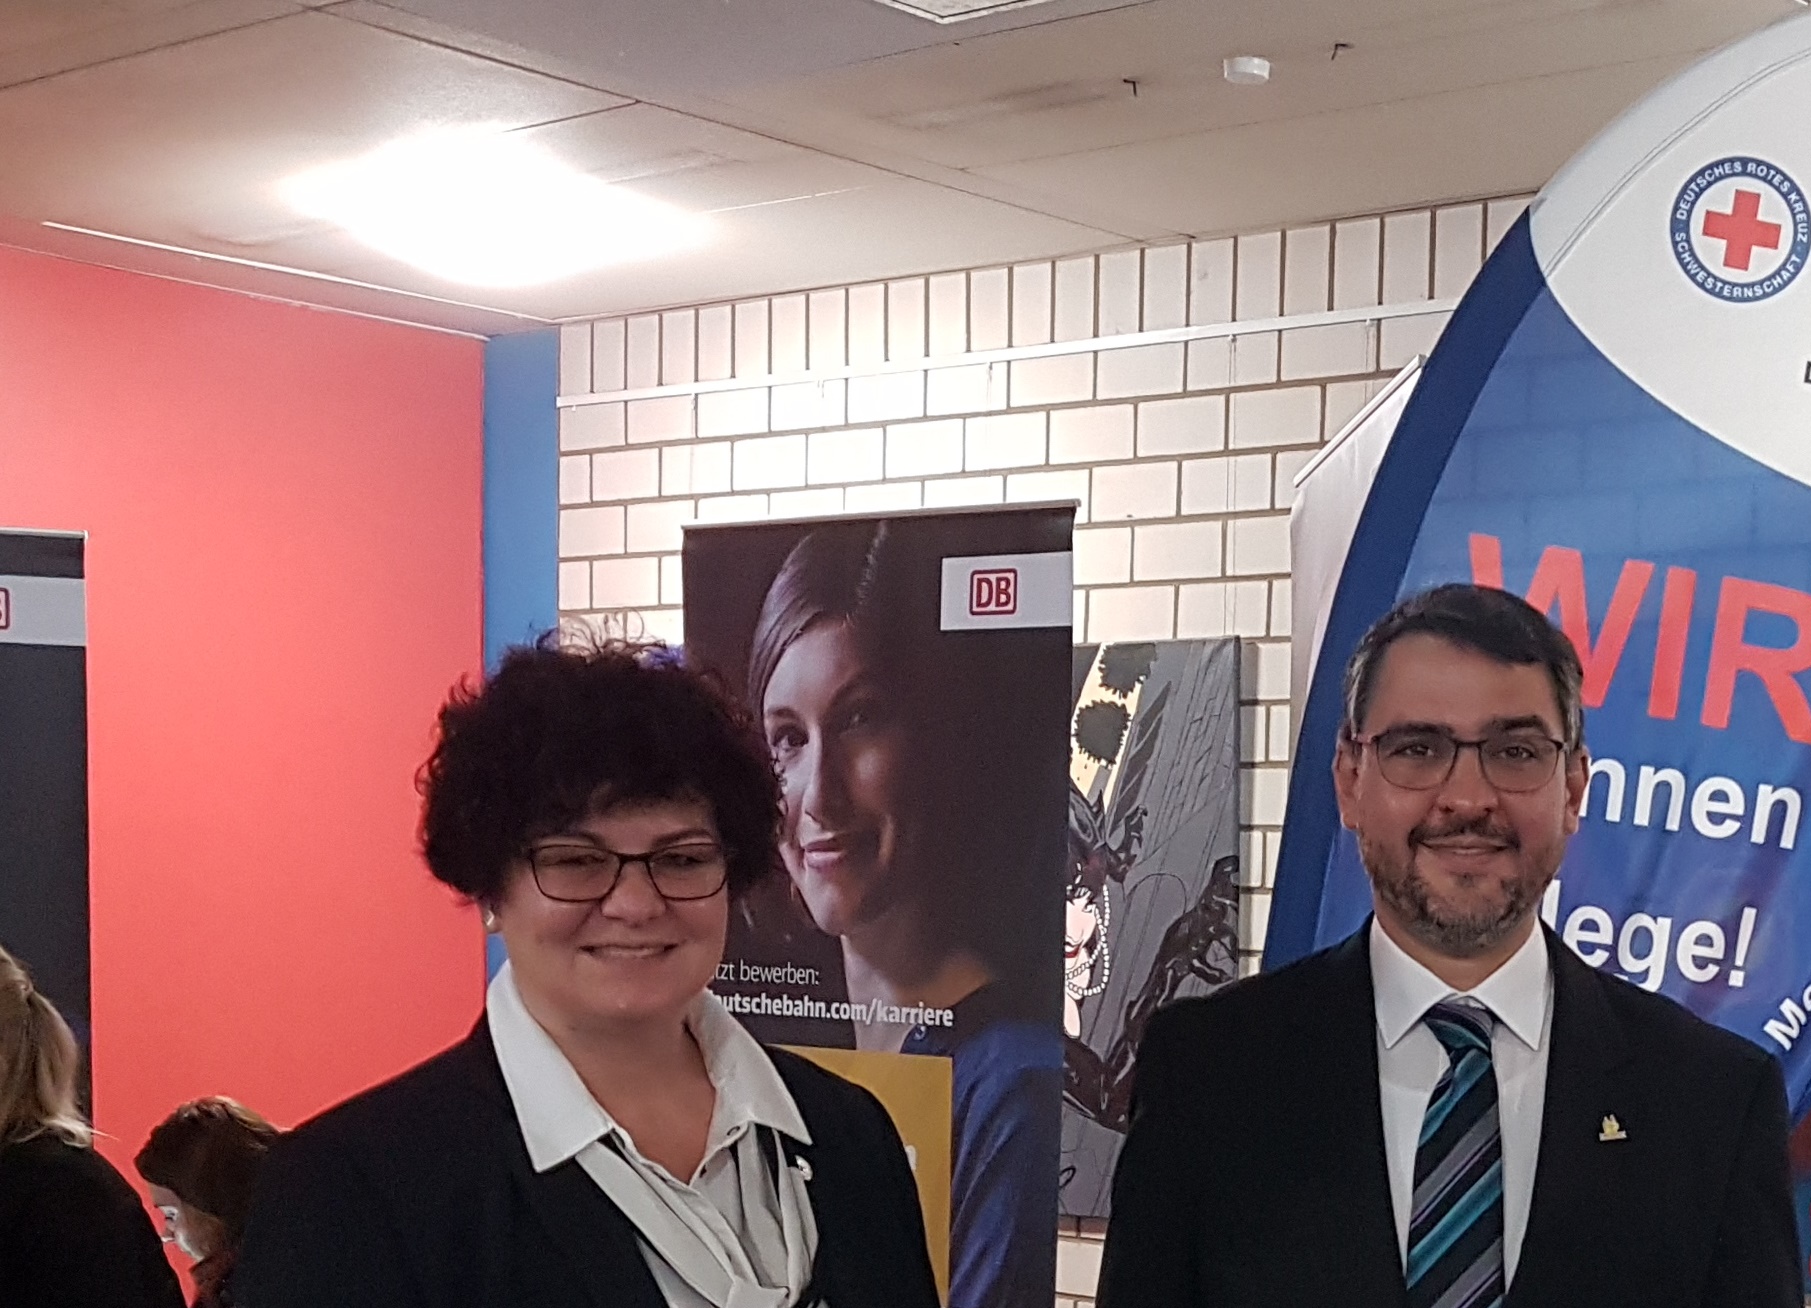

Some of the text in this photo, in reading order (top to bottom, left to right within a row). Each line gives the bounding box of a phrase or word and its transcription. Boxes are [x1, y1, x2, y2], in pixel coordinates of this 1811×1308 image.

[1676, 161, 1809, 243] DEUTSCHES ROTES KREUZ
[1674, 231, 1802, 299] SCHWESTERNSCHAFT
[973, 575, 1014, 611] DB
[1579, 756, 1802, 850] nnen
[1541, 878, 1758, 993] lege!
[715, 959, 820, 985] tzt bewerben:
[716, 992, 954, 1027] utschebahn.com/karriere
